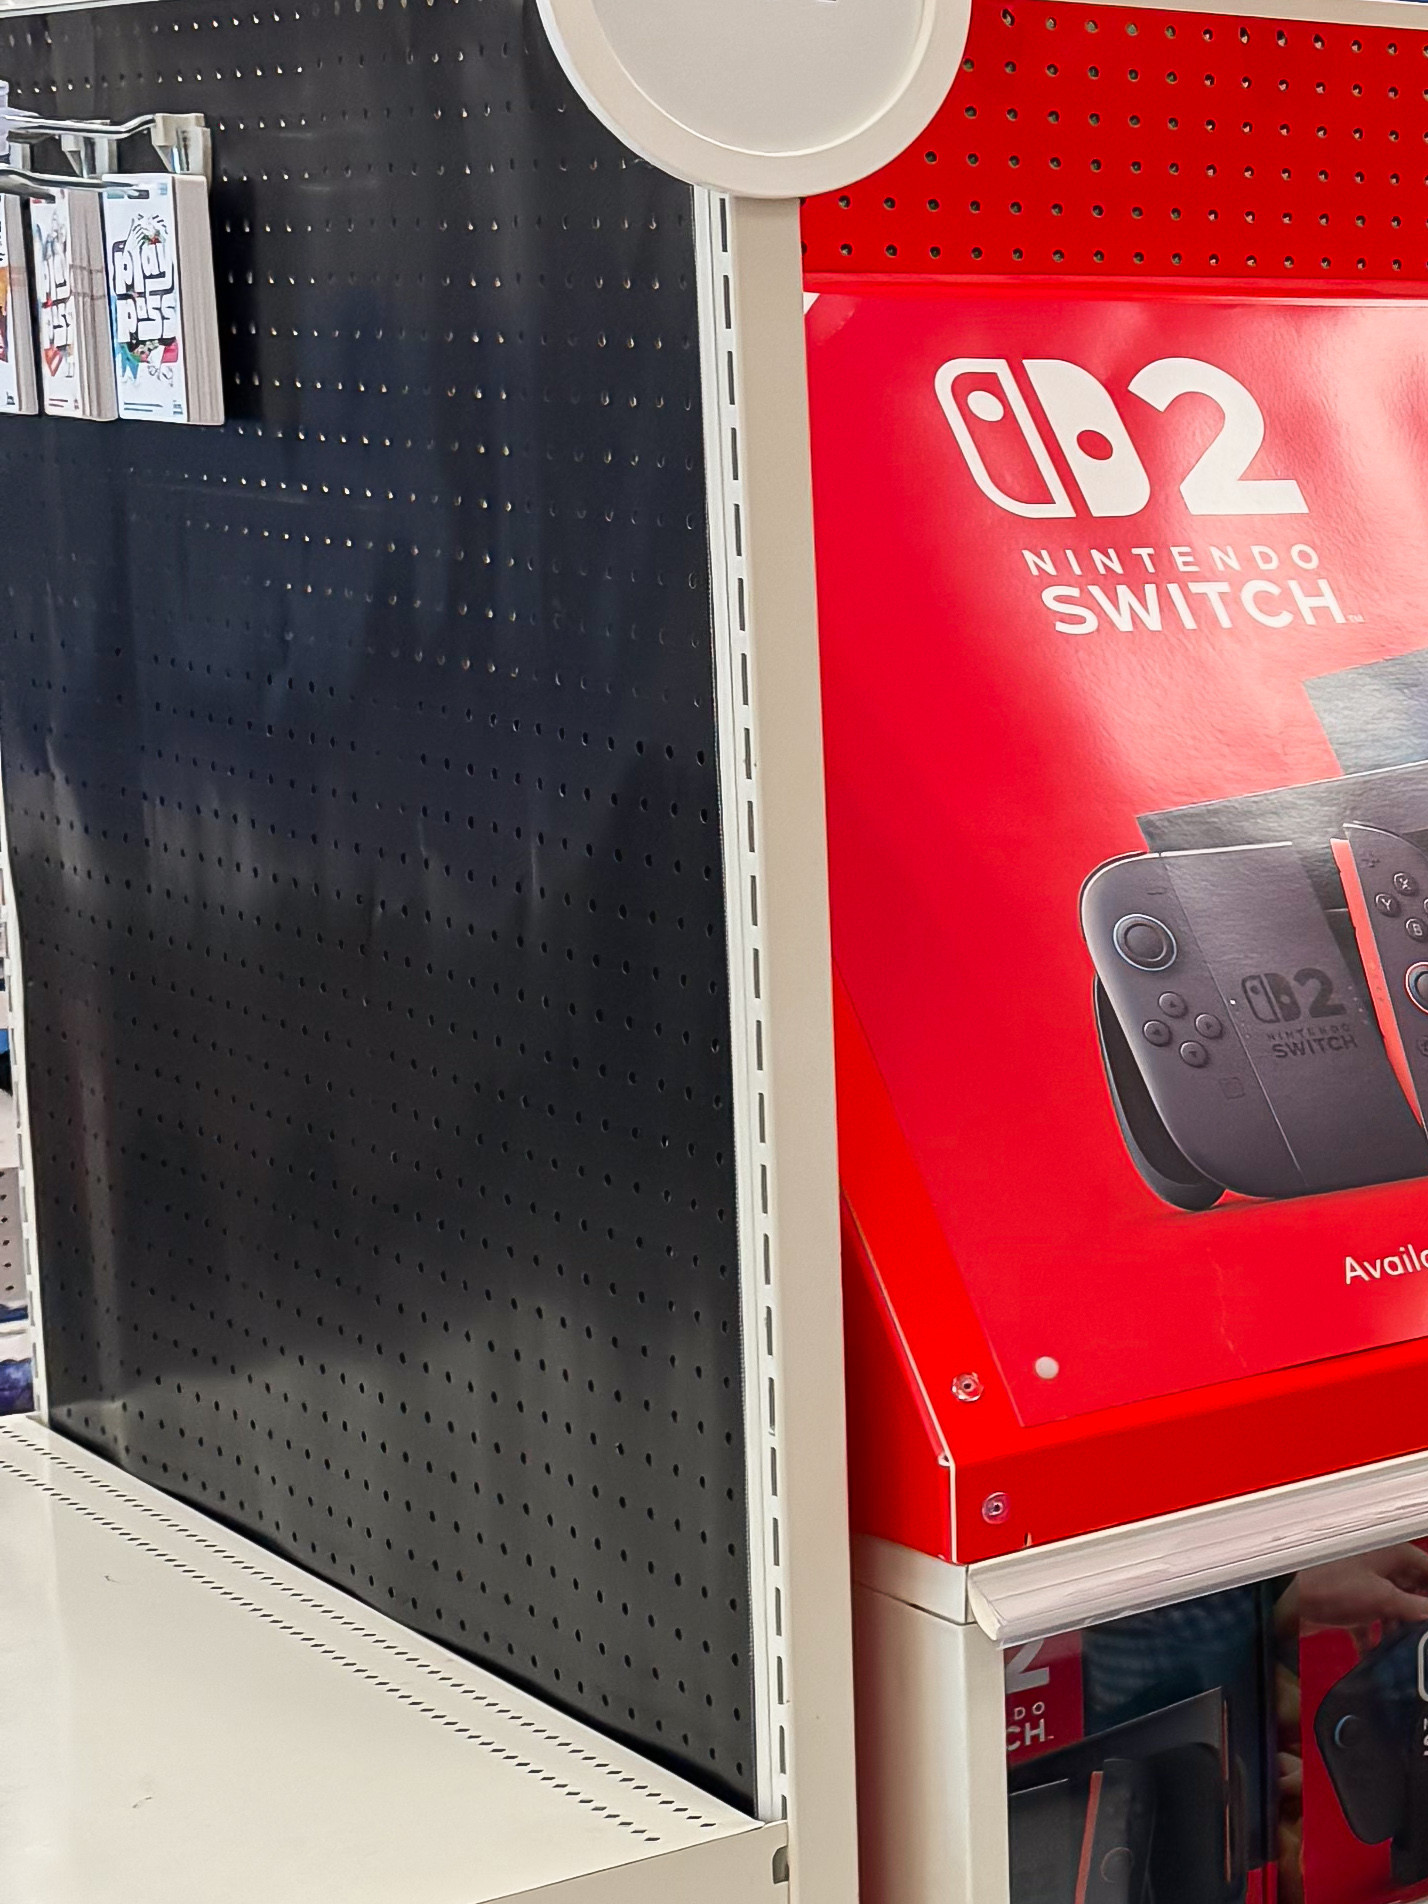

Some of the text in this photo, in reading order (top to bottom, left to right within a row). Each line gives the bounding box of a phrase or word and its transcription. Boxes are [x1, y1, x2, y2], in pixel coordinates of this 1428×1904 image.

[1128, 357, 1310, 516] 2
[1022, 544, 1320, 576] NINTENDO
[1041, 578, 1346, 636] SWITCH
[1271, 1035, 1358, 1058] SWITCH
